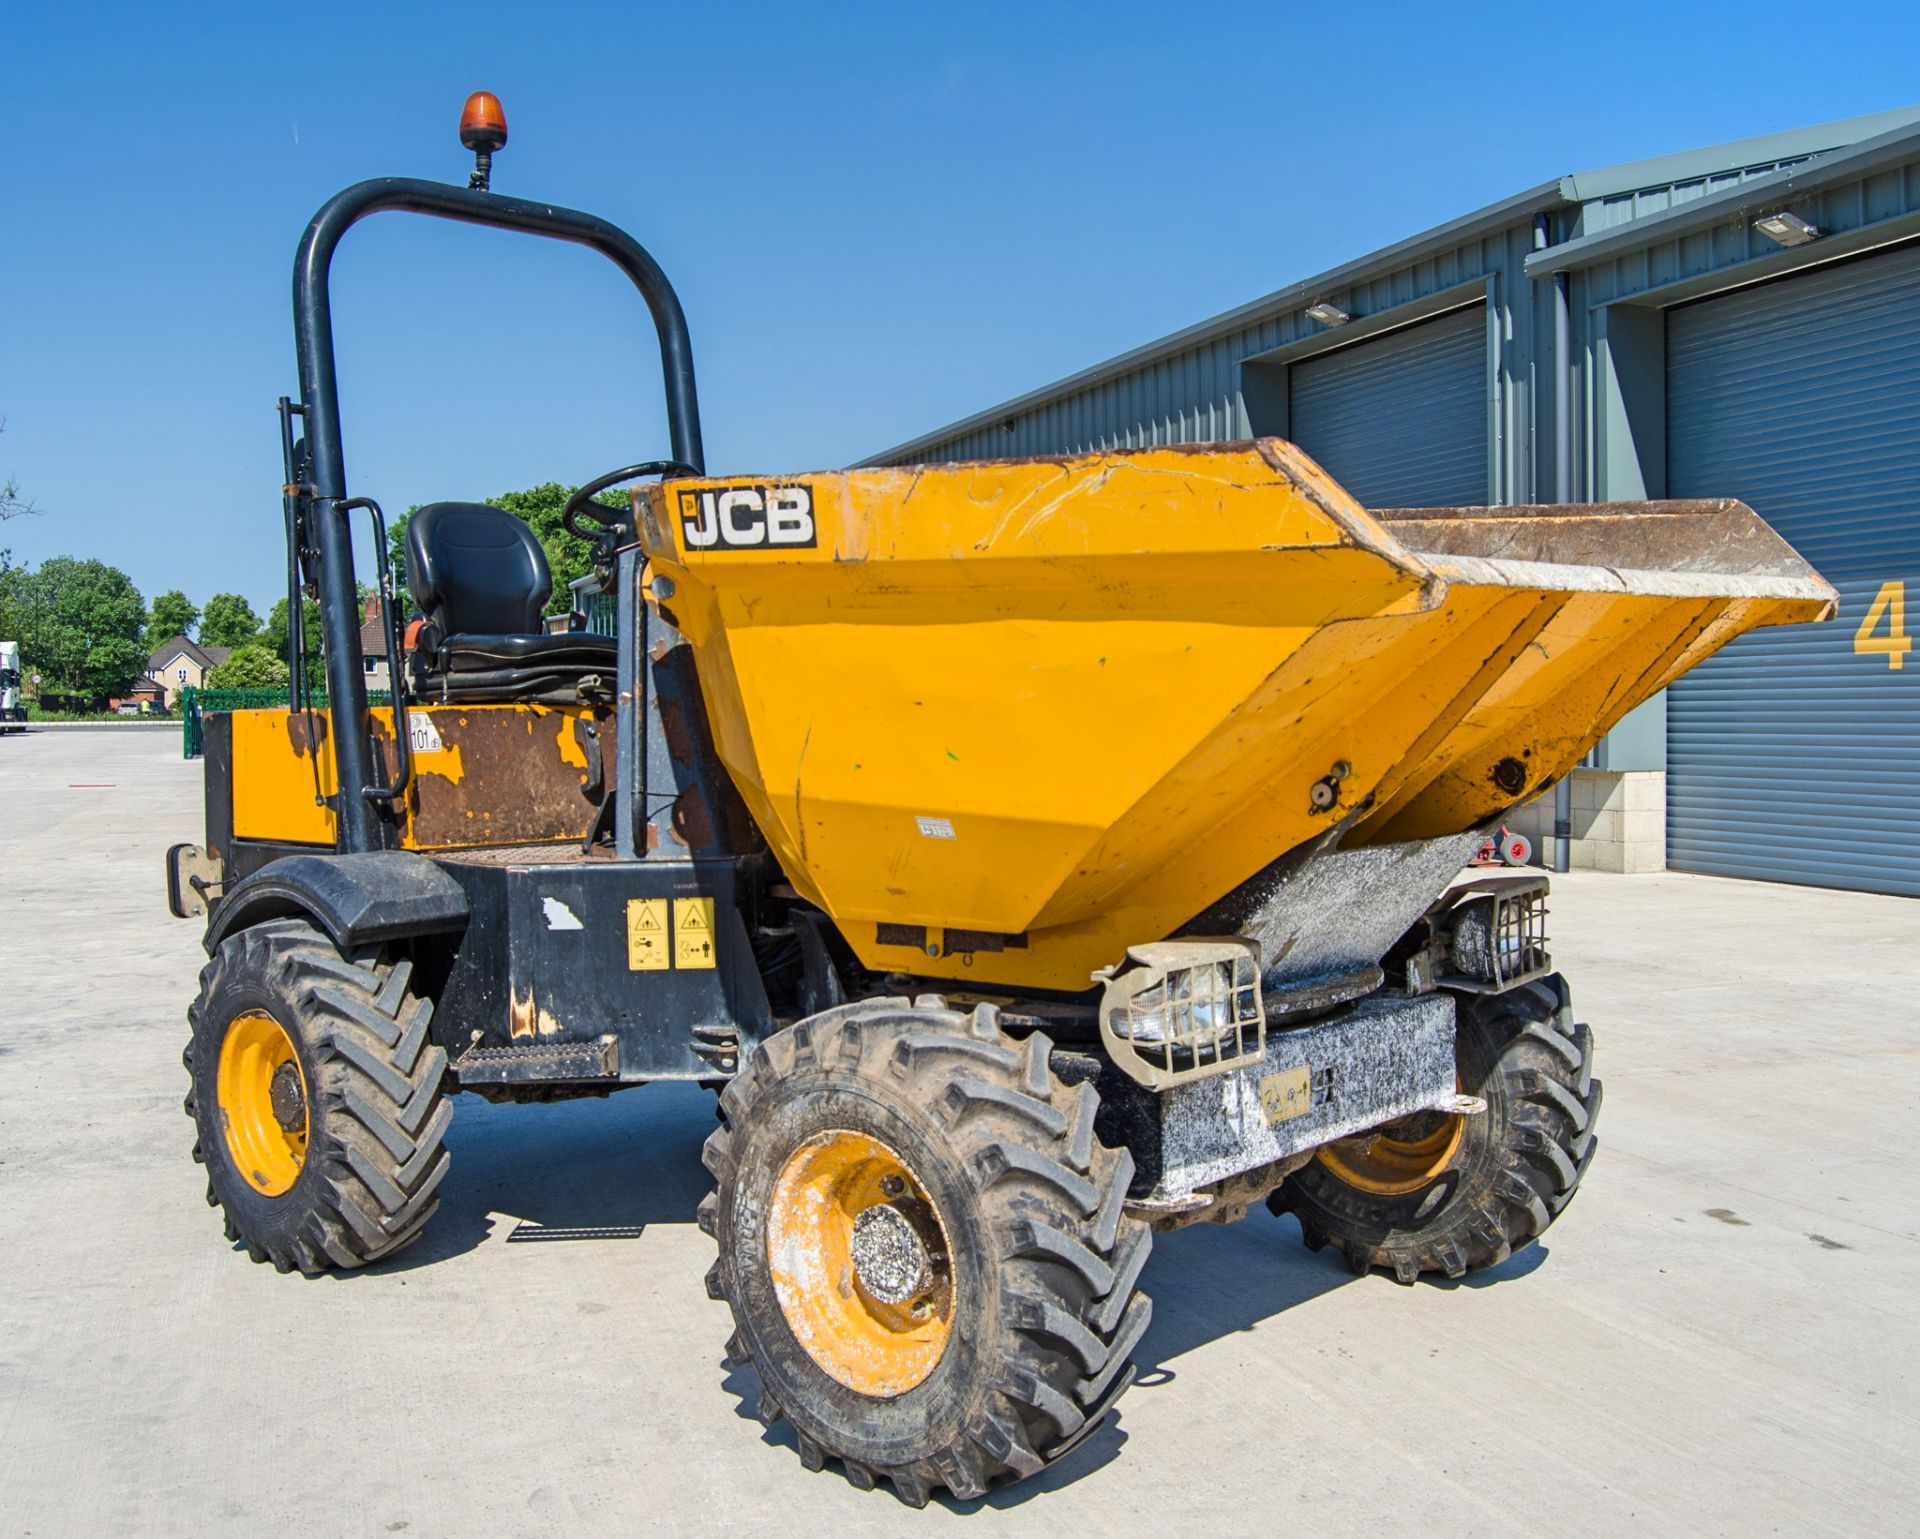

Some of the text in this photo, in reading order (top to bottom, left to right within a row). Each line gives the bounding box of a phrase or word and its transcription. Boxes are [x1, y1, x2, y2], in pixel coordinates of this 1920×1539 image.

[684, 488, 814, 546] JCB
[1854, 581, 1912, 670] 4
[411, 729, 429, 749] 101
